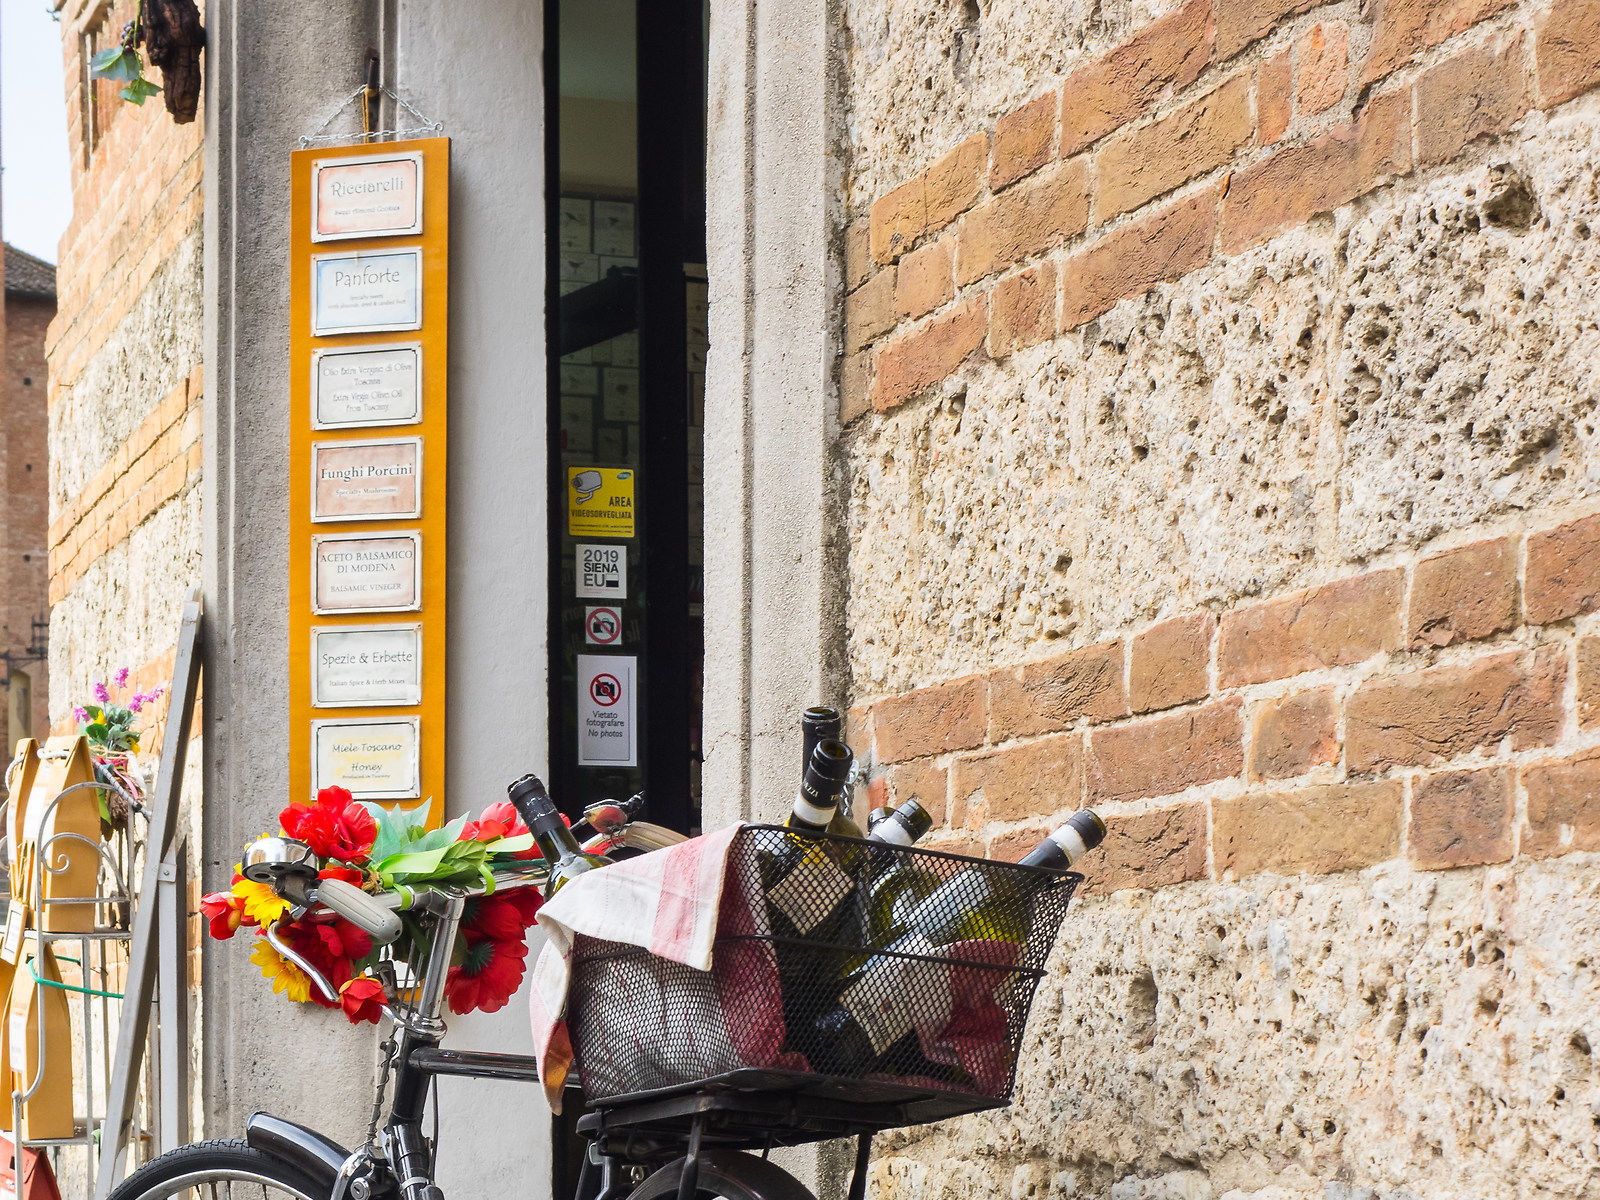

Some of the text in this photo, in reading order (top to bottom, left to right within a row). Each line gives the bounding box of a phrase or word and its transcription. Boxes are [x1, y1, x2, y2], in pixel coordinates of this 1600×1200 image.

[331, 177, 404, 198] Ricciarelli
[335, 264, 400, 287] Panforte
[321, 463, 412, 483] Funghi Porcini
[609, 496, 632, 507] AREA
[571, 509, 632, 519] VIDEOSORVEGLIATA
[320, 550, 413, 563] ACETO BALSAMICO
[584, 549, 619, 562] 2019
[337, 563, 396, 574] DI MODENA
[584, 562, 619, 573] SIENA
[584, 573, 605, 587] EU
[330, 584, 367, 593] BALSAMIC
[322, 650, 413, 668] Spezie & Erbette
[593, 711, 617, 719] Vietato
[586, 718, 625, 728] fotografare
[588, 729, 623, 738] No photos
[332, 743, 403, 753] Miele Toscano
[351, 763, 383, 774] Honey
